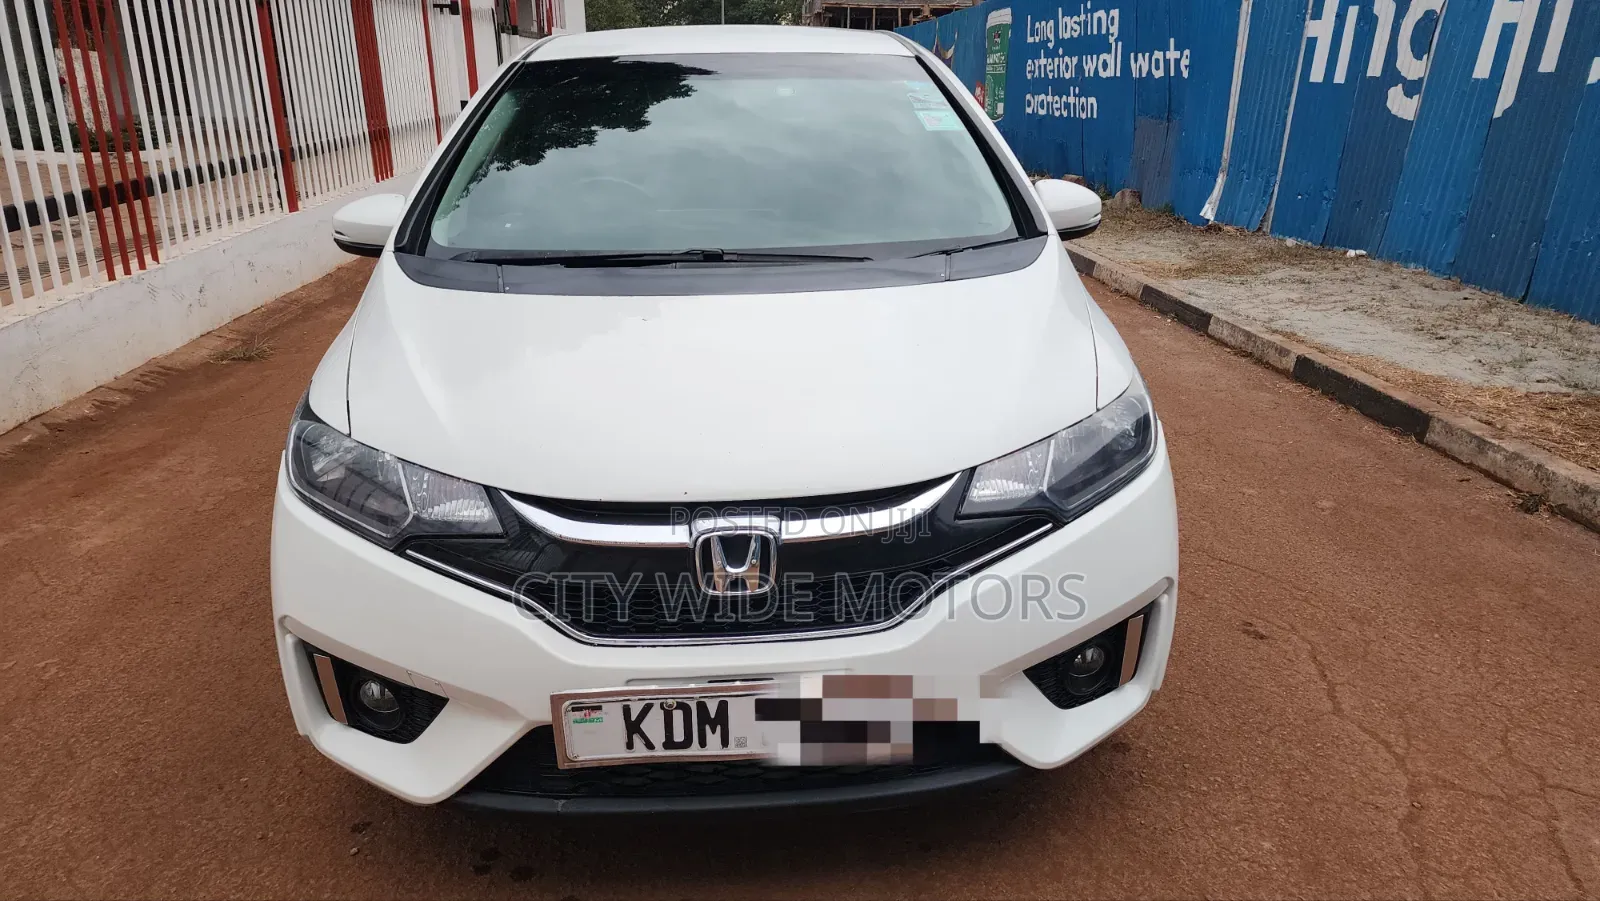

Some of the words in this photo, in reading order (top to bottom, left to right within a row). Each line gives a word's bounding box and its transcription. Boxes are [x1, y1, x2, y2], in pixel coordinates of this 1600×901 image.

[1027, 15, 1054, 49] Long
[1058, 1, 1119, 43] lasting
[1026, 47, 1078, 79] exterior
[1083, 41, 1122, 78] wall
[1025, 86, 1097, 119] protection
[622, 700, 730, 750] KDM
